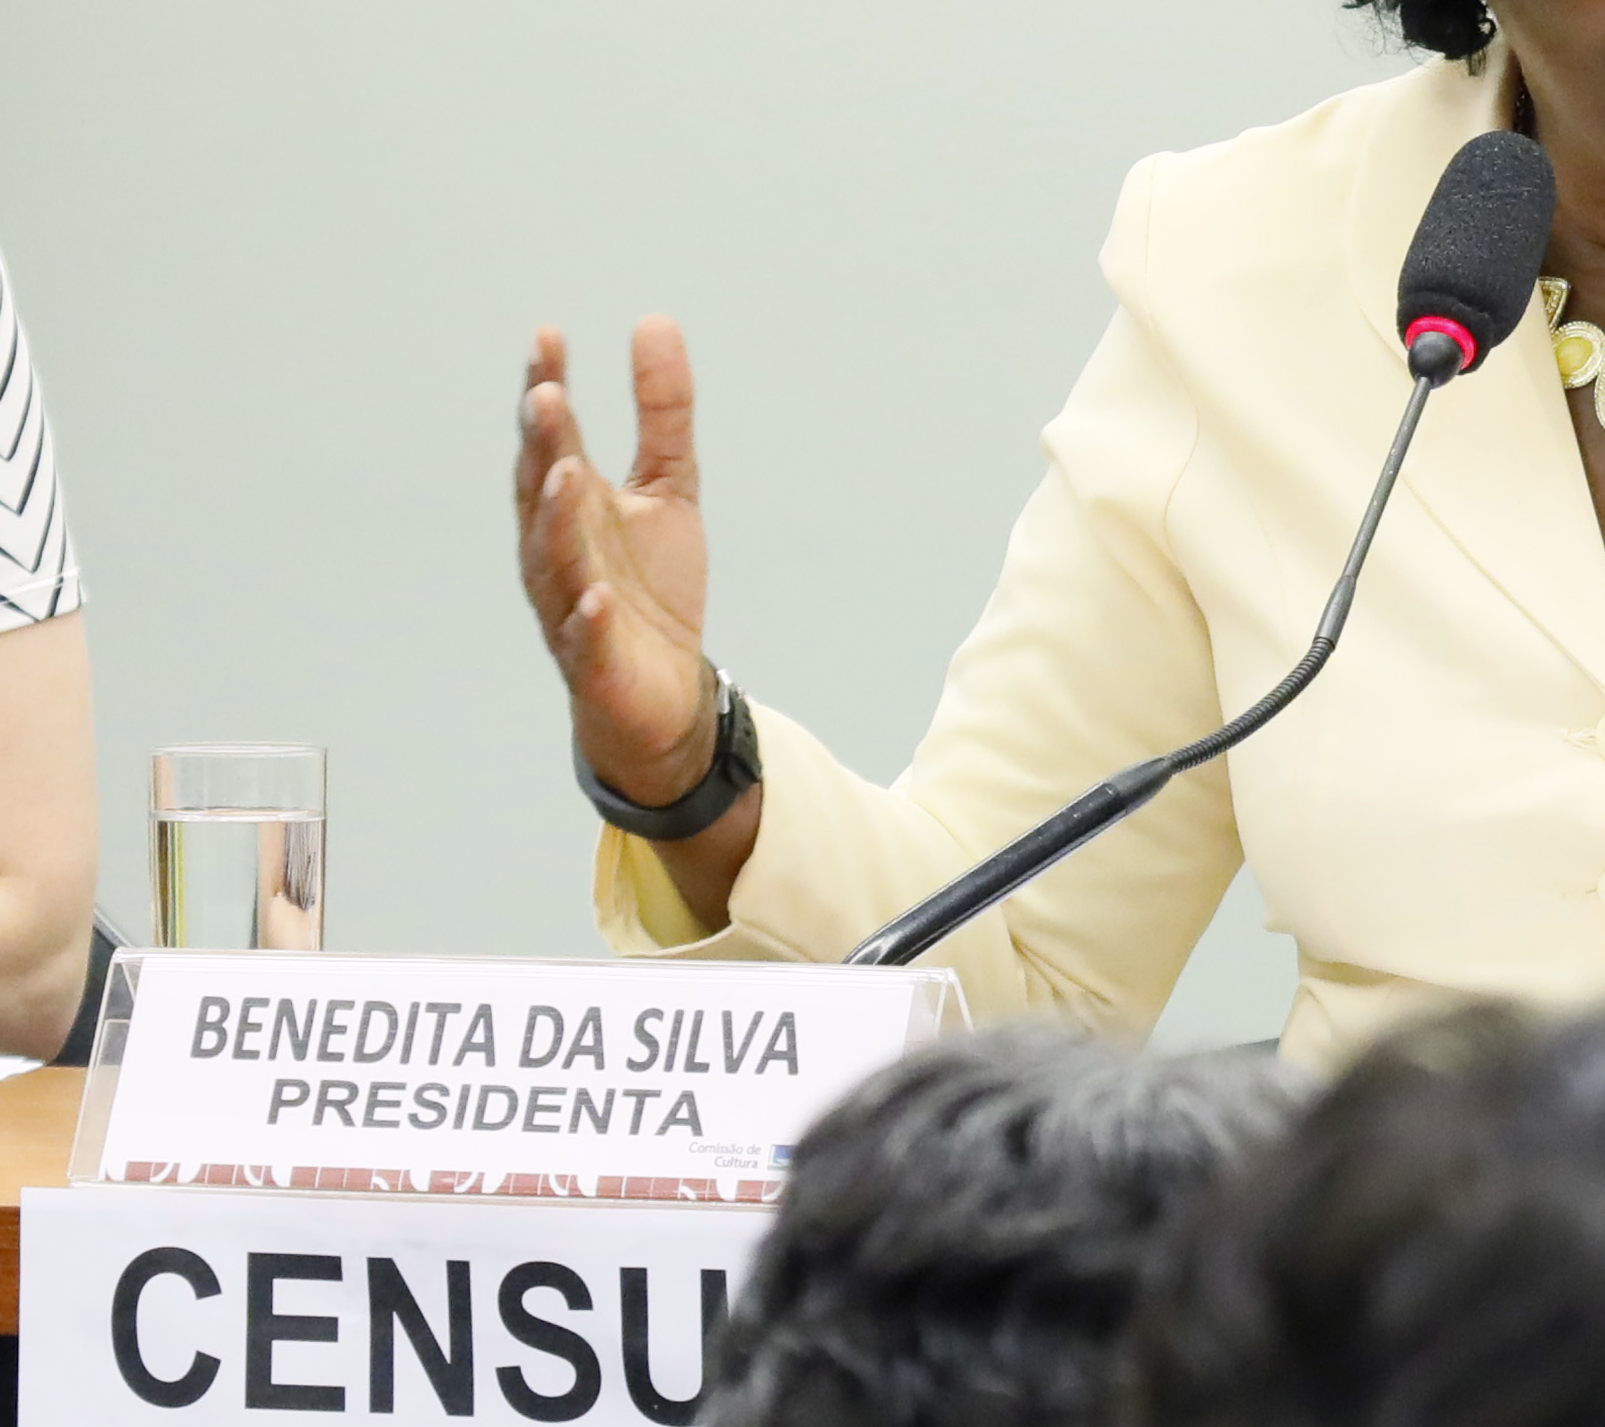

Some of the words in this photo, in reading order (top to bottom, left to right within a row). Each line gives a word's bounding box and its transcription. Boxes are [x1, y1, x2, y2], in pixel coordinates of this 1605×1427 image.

[190, 995, 496, 1067] BENEDITA
[518, 1004, 604, 1071] DA
[626, 1007, 799, 1076] SILVA
[266, 1079, 704, 1137] PRESIDENTA
[689, 1142, 743, 1154] Comissão
[747, 1144, 761, 1155] de
[714, 1156, 758, 1169] Cultura
